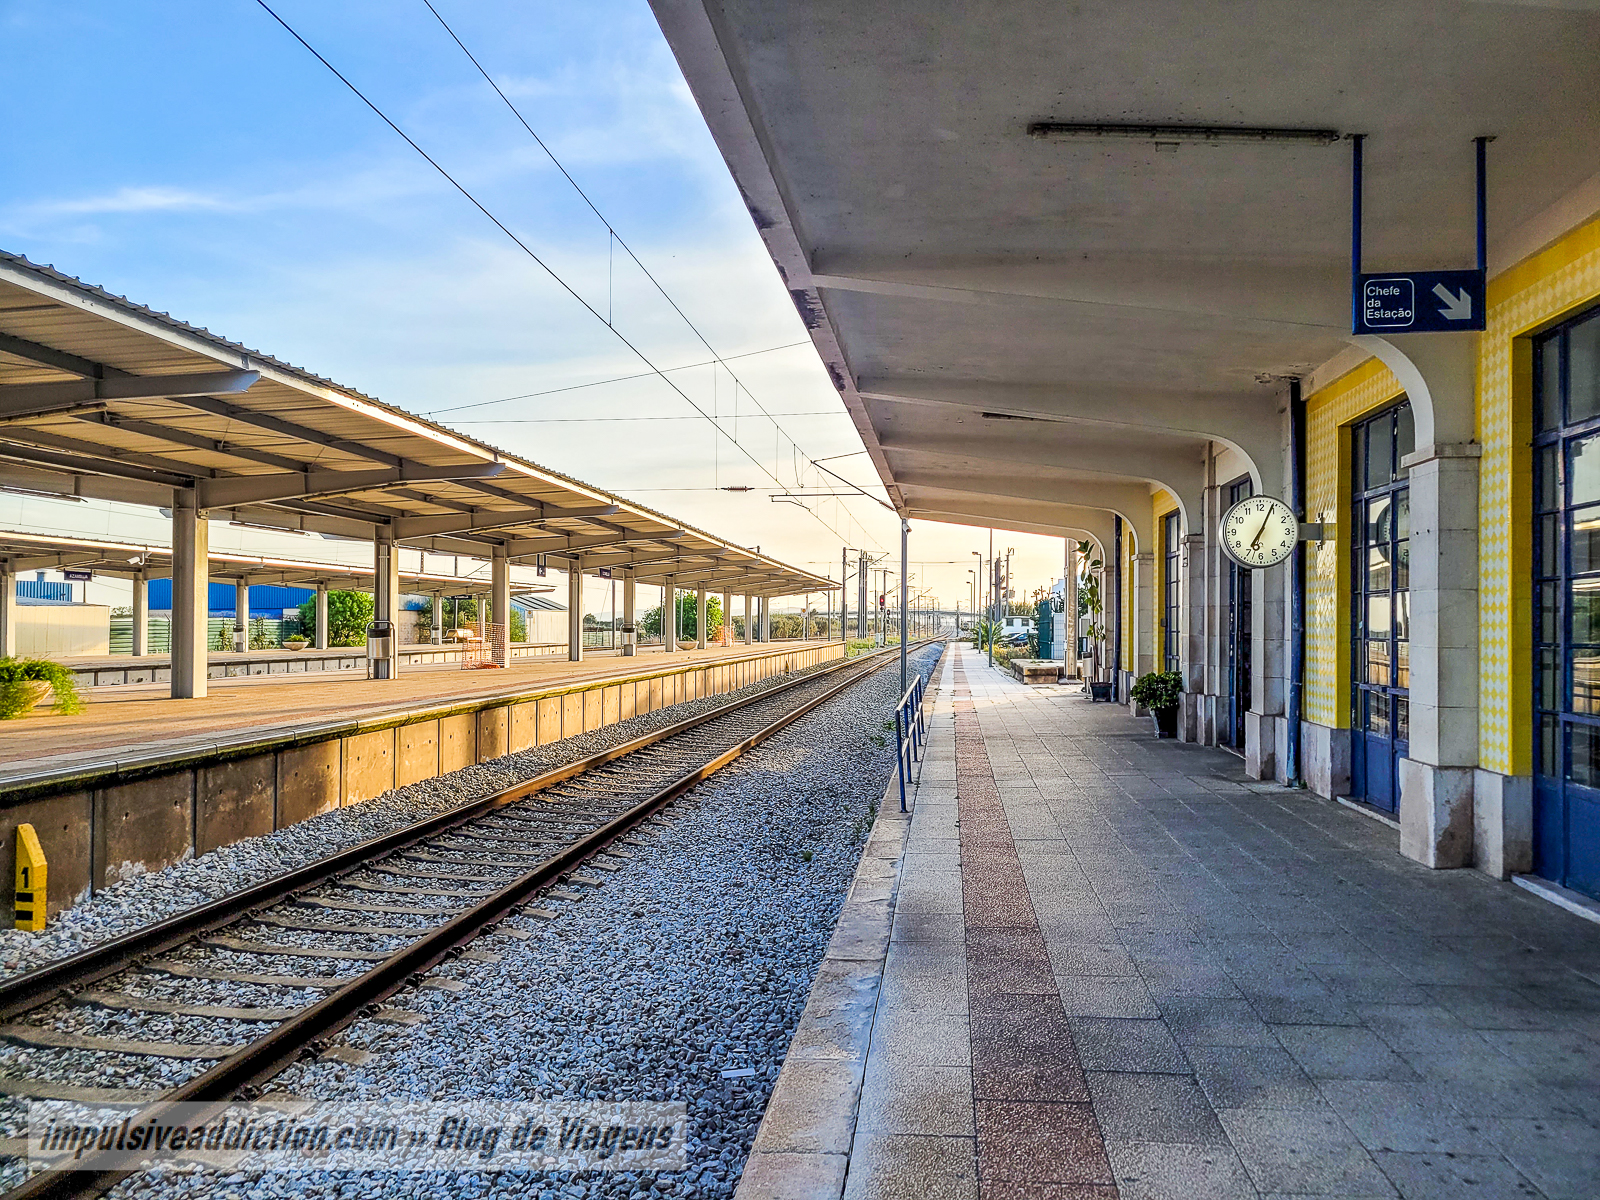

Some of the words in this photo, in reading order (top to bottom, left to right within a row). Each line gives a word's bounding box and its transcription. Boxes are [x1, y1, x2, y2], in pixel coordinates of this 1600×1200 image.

[1367, 286, 1400, 296] Chefe
[1367, 299, 1381, 308] da
[1366, 308, 1412, 320] Estação
[1245, 507, 1251, 515] 11
[1256, 503, 1265, 512] 12
[1235, 516, 1244, 524] 10
[1280, 516, 1287, 524] 2
[1231, 528, 1237, 536] 9
[1284, 528, 1291, 536] 3
[1235, 540, 1242, 548] 8
[1280, 540, 1286, 548] 4
[1245, 549, 1252, 557] 7
[1258, 552, 1264, 561] 6
[1271, 549, 1277, 557] 5
[21, 867, 29, 889] 1
